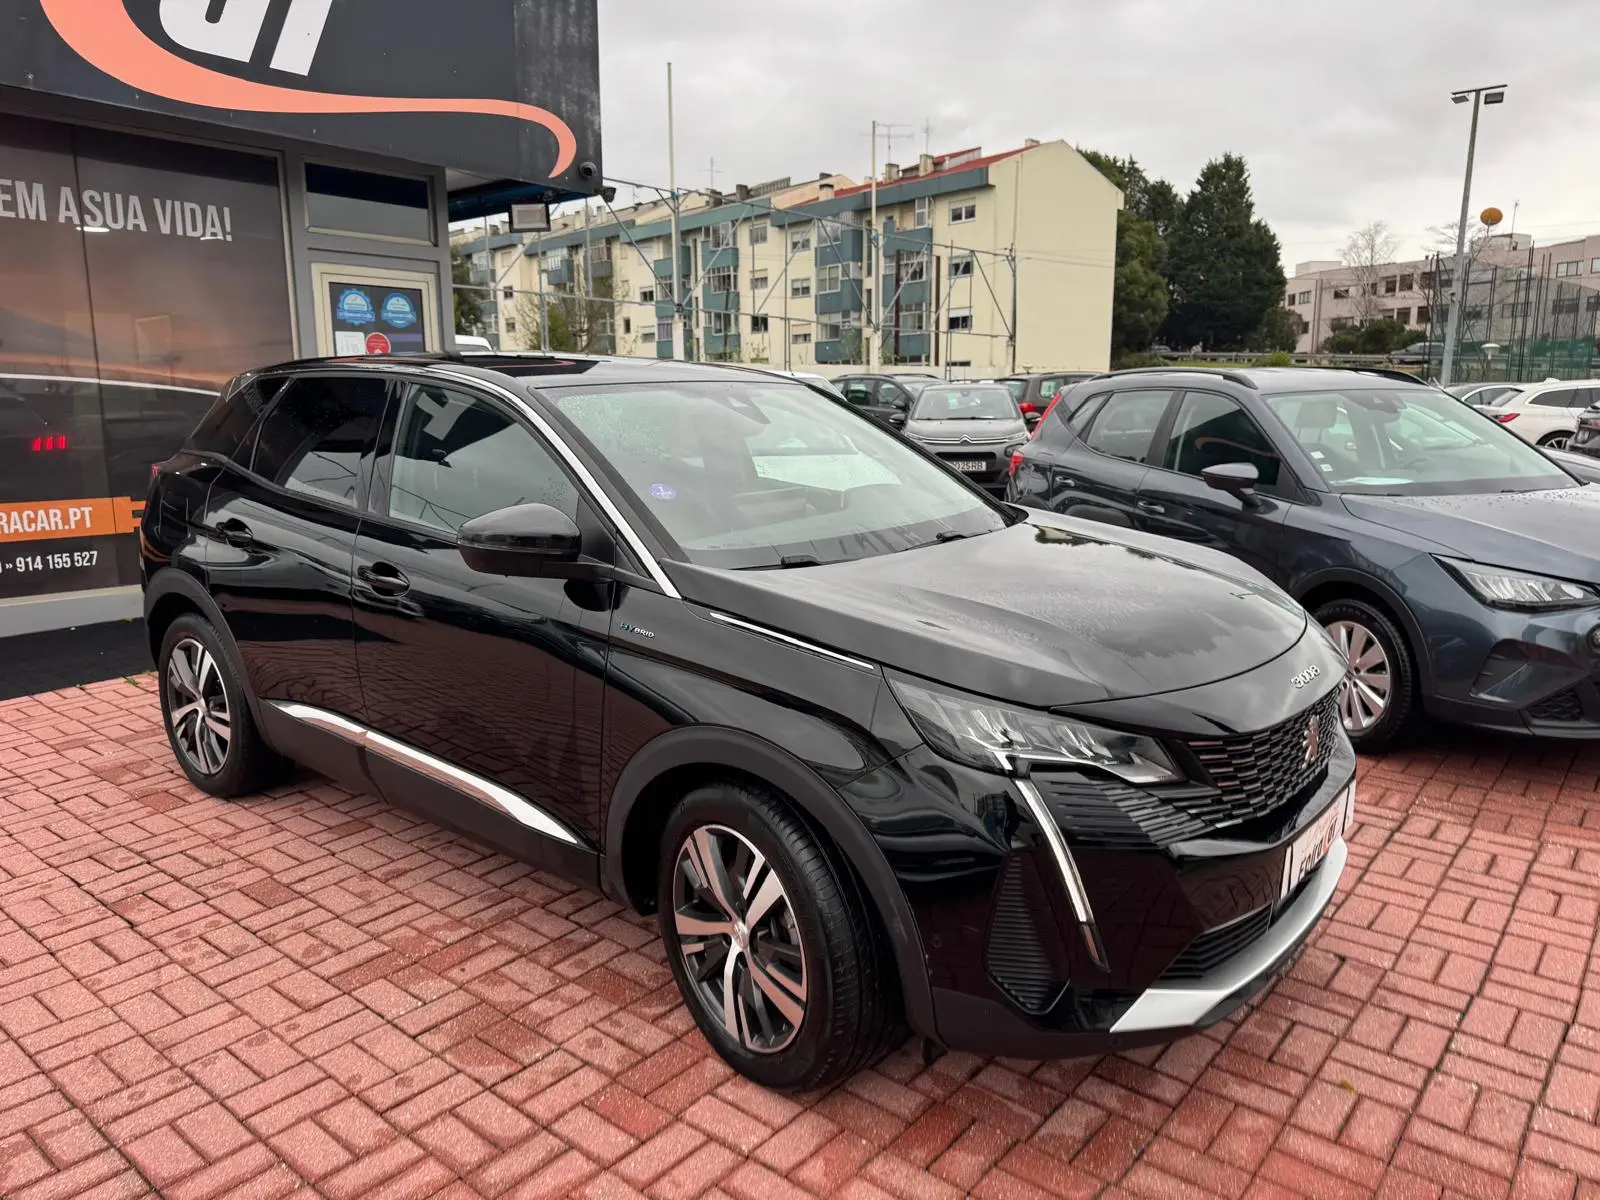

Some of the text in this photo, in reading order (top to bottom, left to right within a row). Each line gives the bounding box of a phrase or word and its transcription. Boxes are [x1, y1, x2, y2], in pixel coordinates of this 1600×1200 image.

[153, 198, 233, 242] VIDA!
[16, 555, 43, 572] 914
[46, 552, 71, 570] 155
[73, 550, 98, 567] 527
[620, 622, 655, 638] HYBRID
[1290, 664, 1320, 688] 3008
